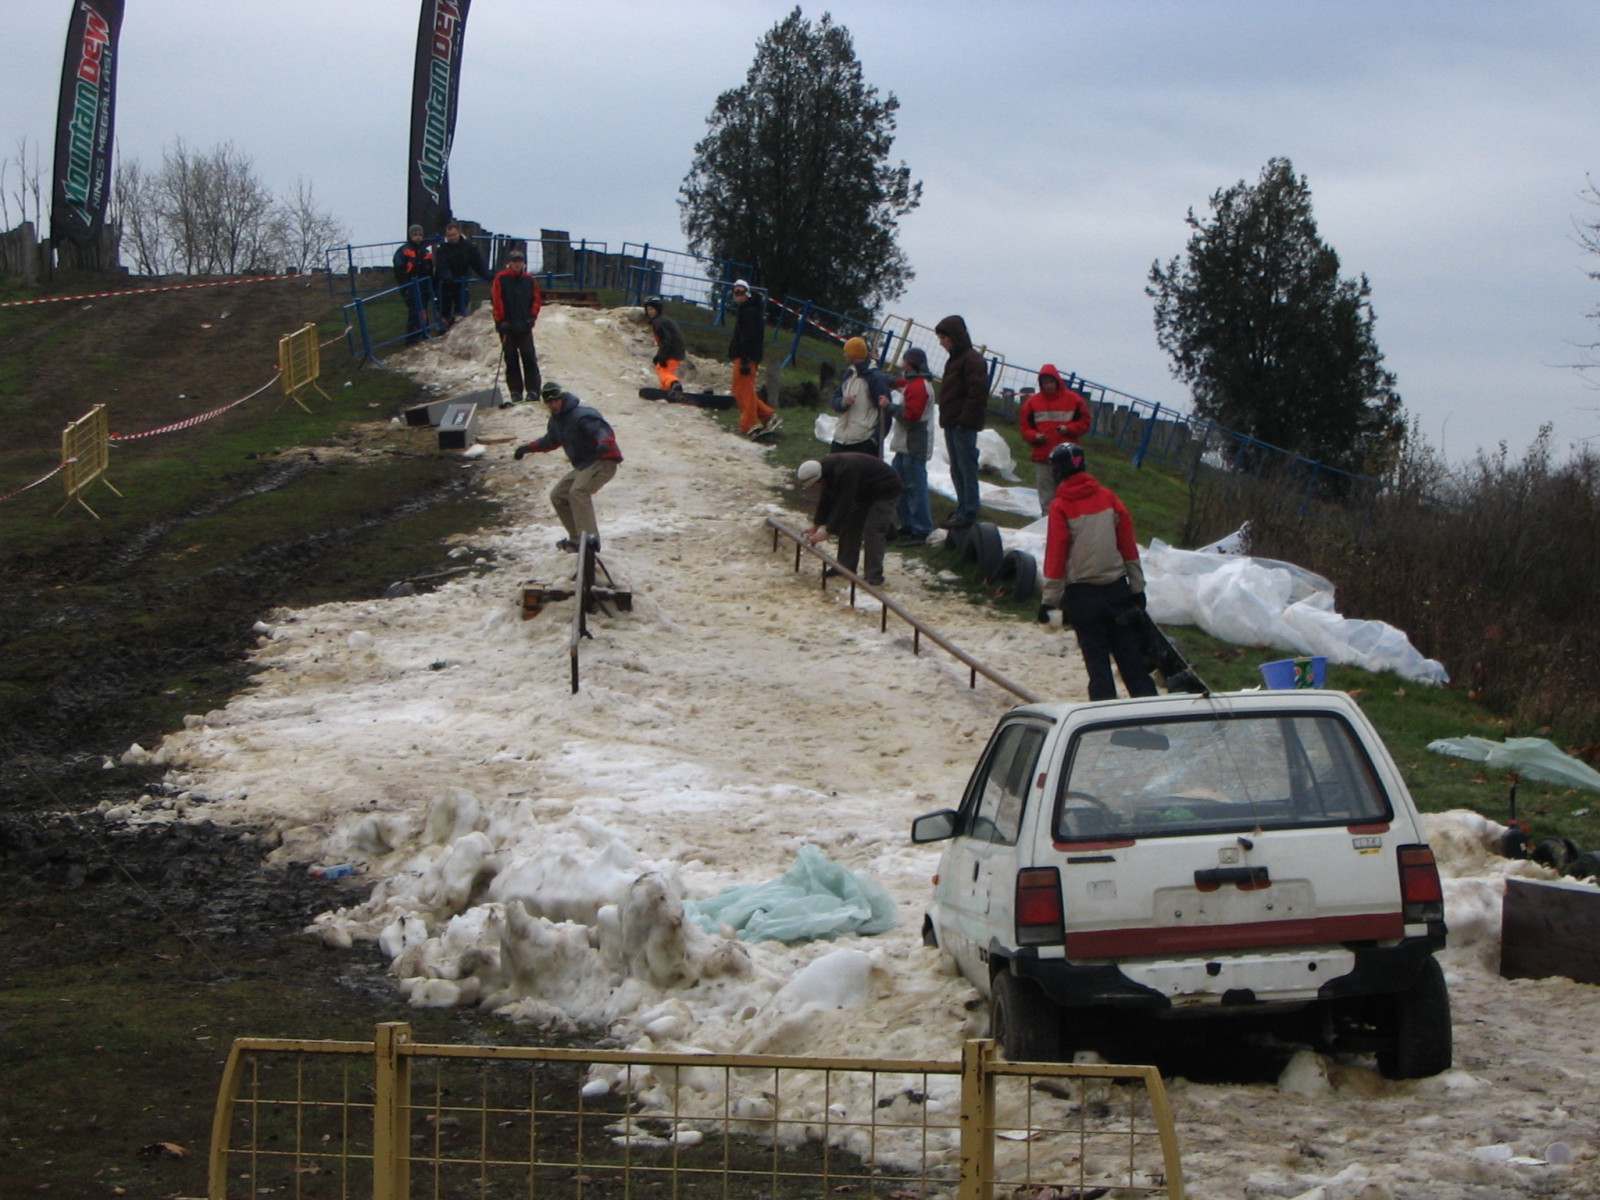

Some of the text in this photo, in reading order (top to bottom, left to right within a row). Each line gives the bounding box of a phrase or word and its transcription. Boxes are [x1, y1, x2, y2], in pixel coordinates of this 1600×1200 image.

[62, 81, 99, 227] Mountain
[93, 158, 105, 209] NINCS
[417, 59, 450, 204] Mountain
